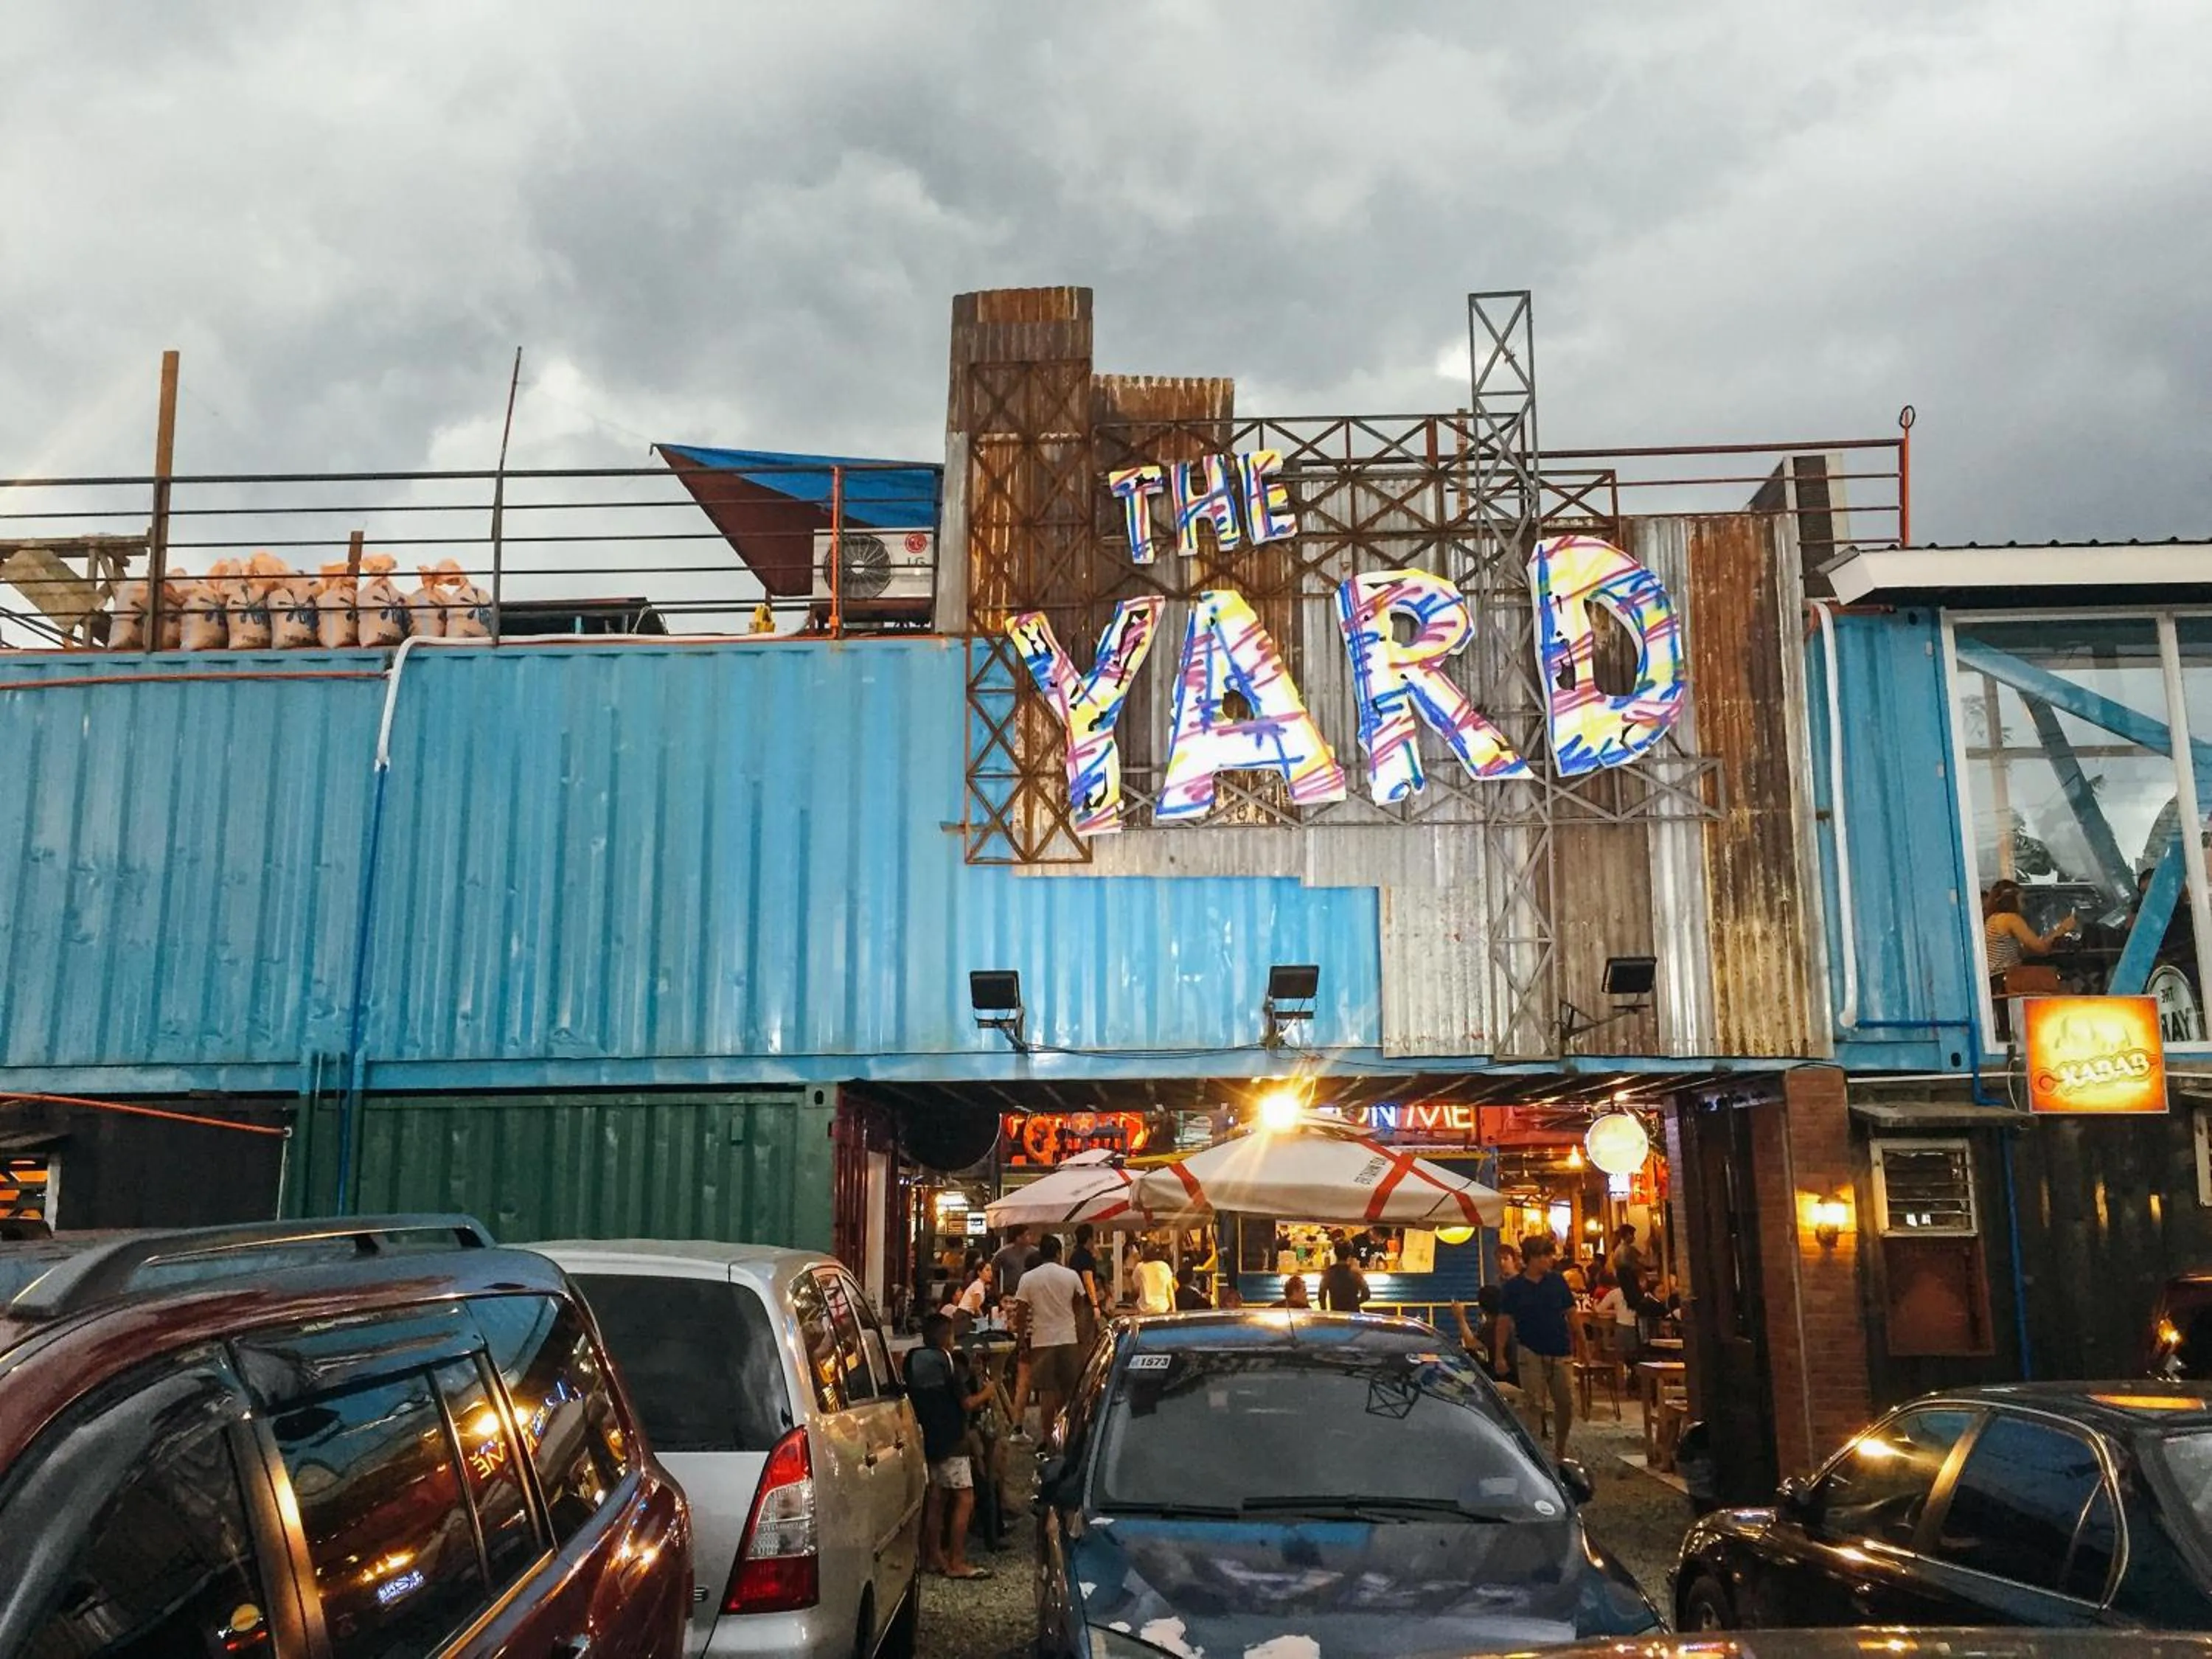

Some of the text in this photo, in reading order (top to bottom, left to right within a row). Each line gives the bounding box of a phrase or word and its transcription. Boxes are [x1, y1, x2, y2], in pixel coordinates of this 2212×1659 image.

[1108, 448, 1298, 565] THE
[1004, 535, 1688, 836] YARD
[1405, 1105, 1474, 1129] ME
